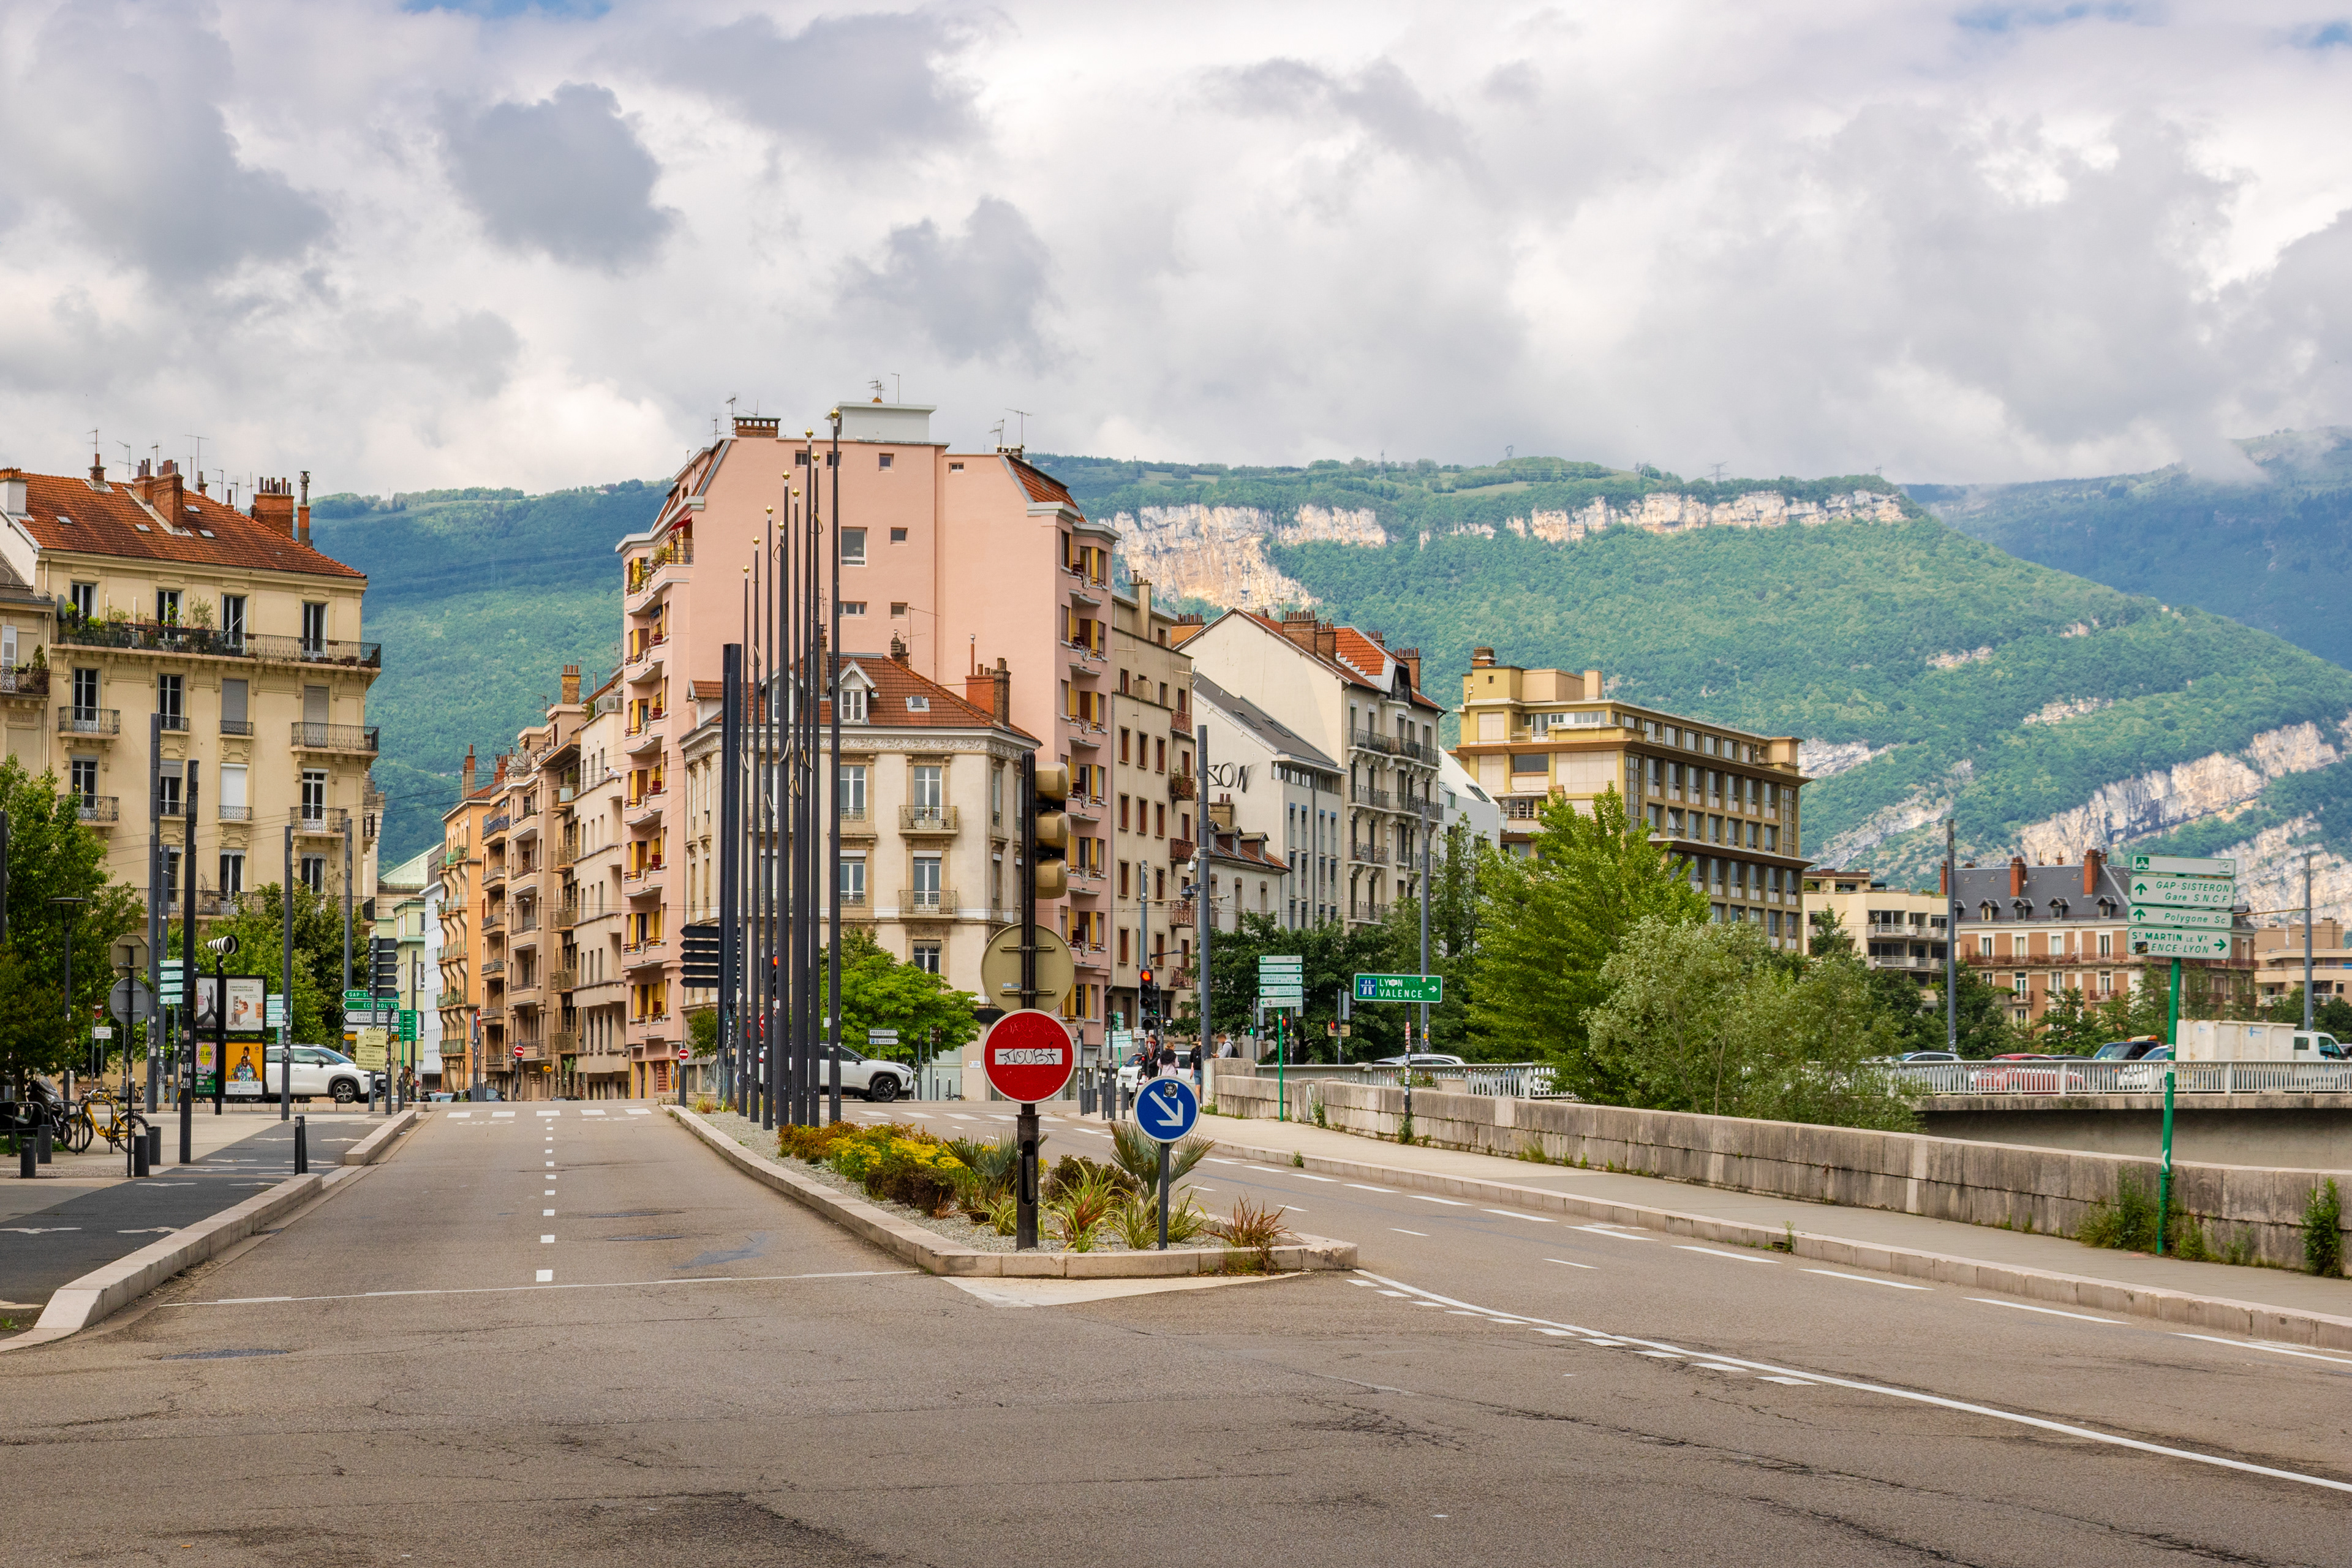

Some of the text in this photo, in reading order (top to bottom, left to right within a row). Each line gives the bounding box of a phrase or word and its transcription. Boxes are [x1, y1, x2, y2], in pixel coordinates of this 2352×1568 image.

[2156, 881, 2230, 893] GAP-SISTERON
[2165, 892, 2230, 903] Gare S.N.C.F.
[2164, 913, 2229, 924] Polygone Sc.
[2145, 933, 2182, 942] MARTIN
[2132, 942, 2209, 954] VENCE-LYON
[1379, 979, 1403, 987] LYN
[1379, 989, 1423, 998] VALENCE
